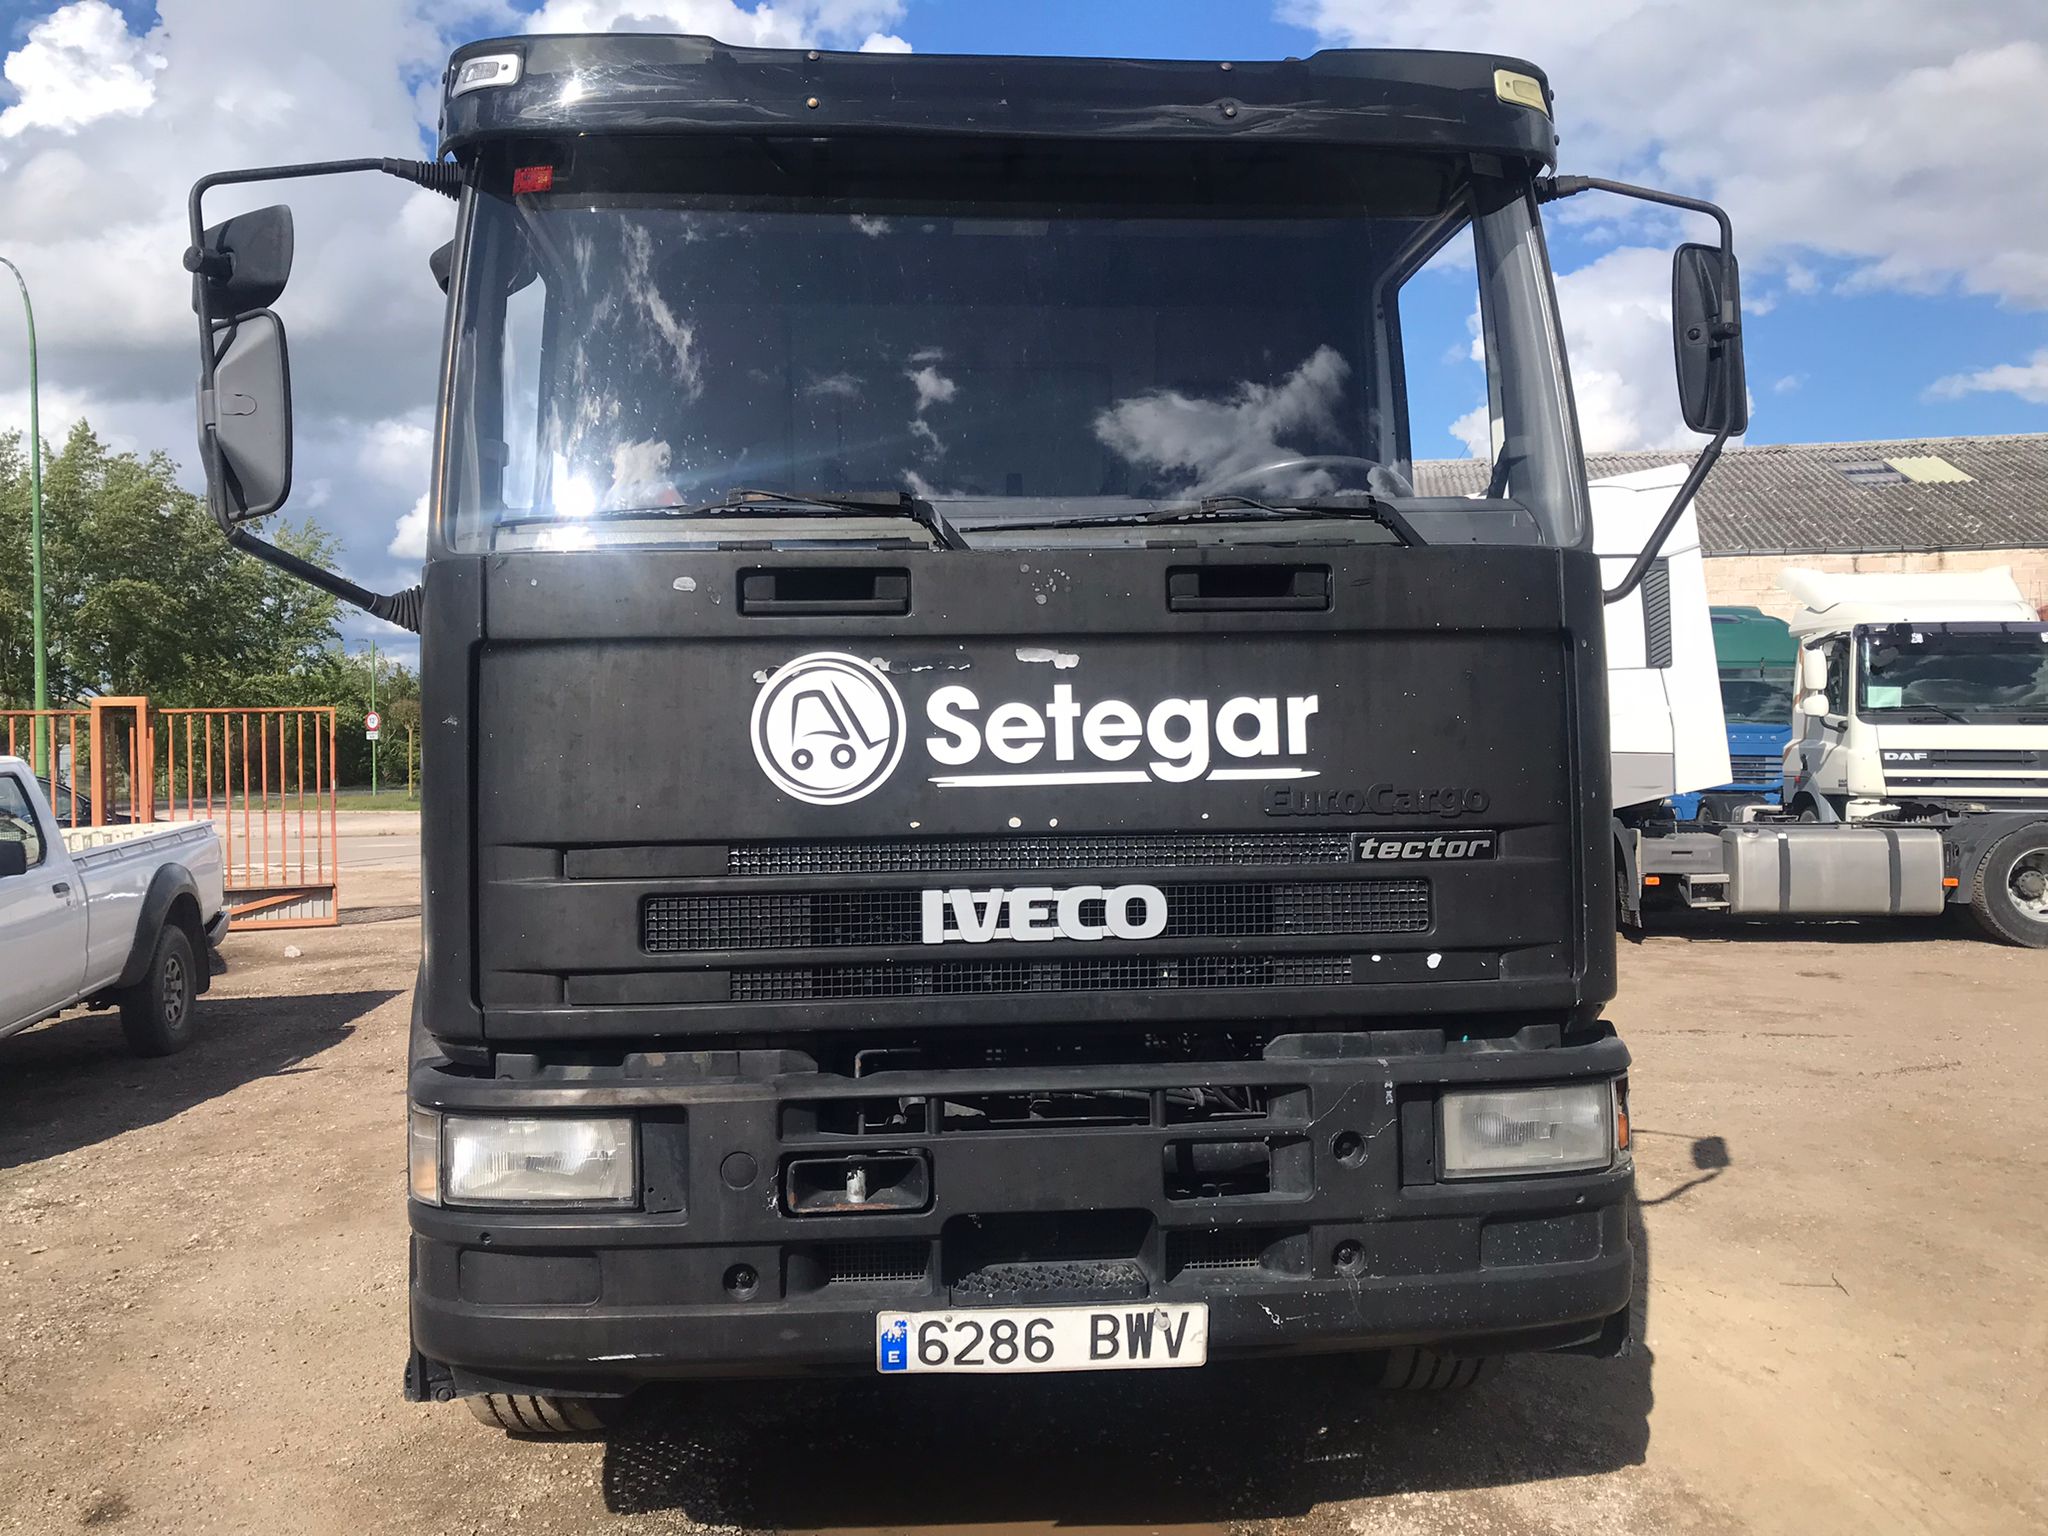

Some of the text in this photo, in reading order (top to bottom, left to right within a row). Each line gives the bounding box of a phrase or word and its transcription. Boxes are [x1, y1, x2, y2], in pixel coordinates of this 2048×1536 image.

[926, 684, 1319, 783] Setegar
[1884, 752, 1928, 761] DAF
[1264, 784, 1490, 817] EuroCargo
[1360, 836, 1490, 860] tector
[922, 885, 1168, 944] IVECO
[888, 1311, 1190, 1367] E 6286 BWV
